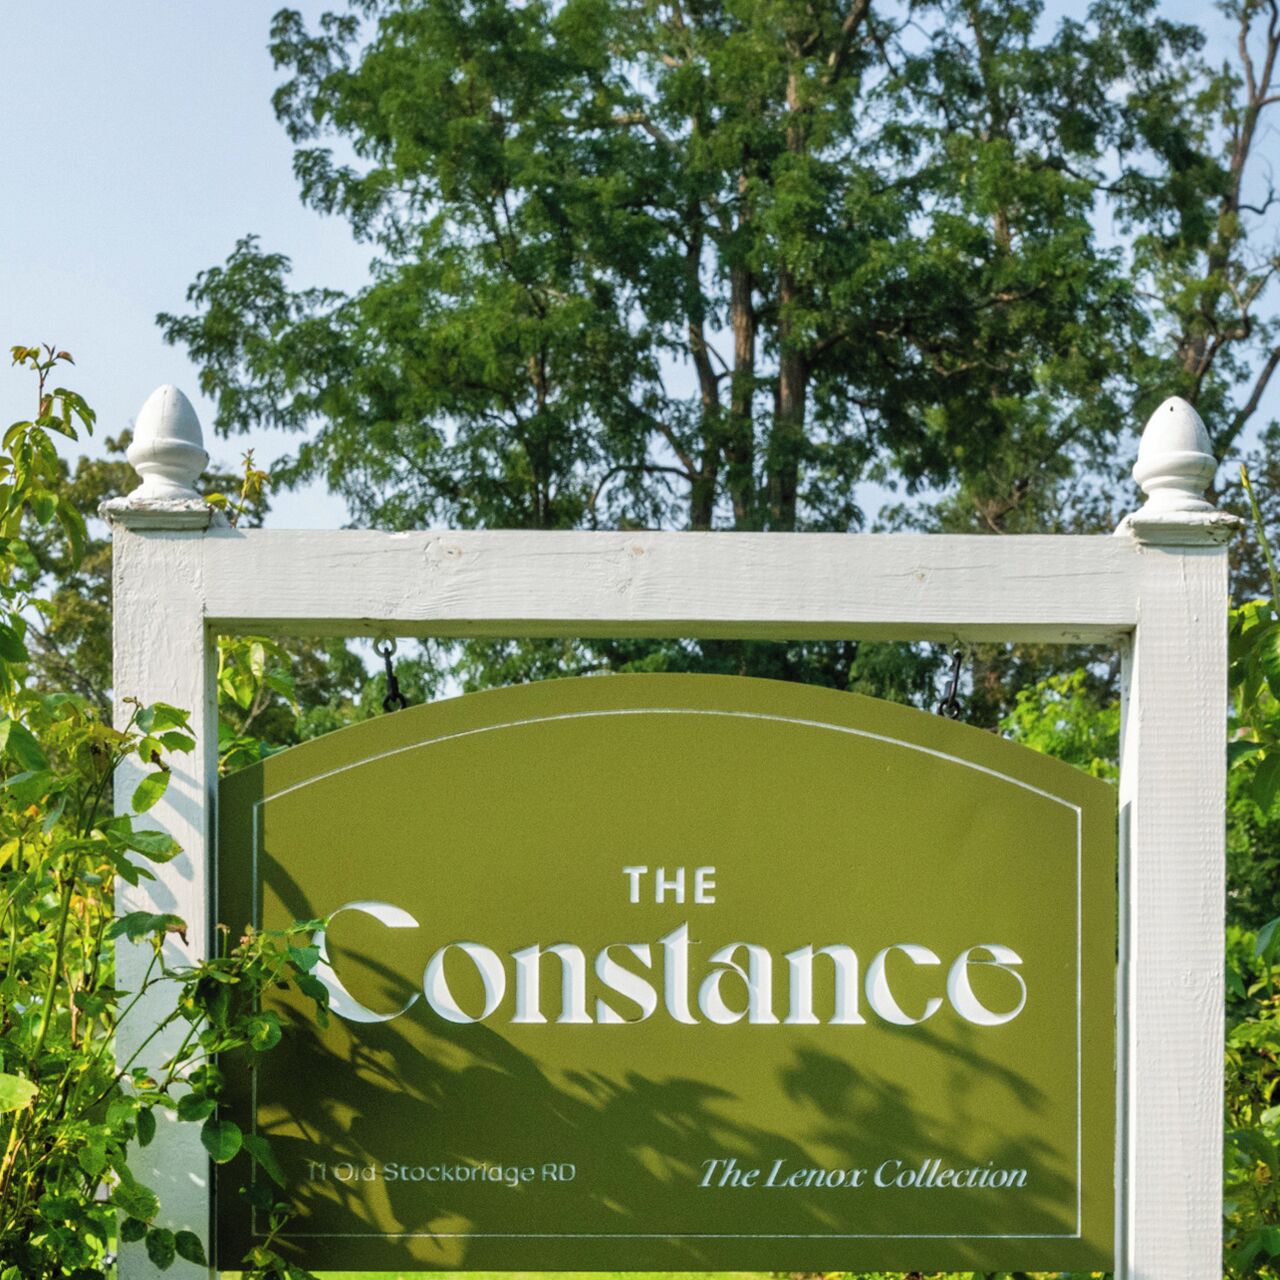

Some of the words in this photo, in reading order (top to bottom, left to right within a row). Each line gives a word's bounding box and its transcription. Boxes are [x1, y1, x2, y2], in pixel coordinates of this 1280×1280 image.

[623, 865, 716, 904] THE
[308, 899, 1029, 1025] Constance
[333, 1161, 376, 1181] Old
[383, 1161, 535, 1187] Stockbridge
[542, 1162, 576, 1181] RD
[697, 1157, 760, 1188] The
[762, 1158, 868, 1188] Lenox
[873, 1157, 1028, 1188] Collection
